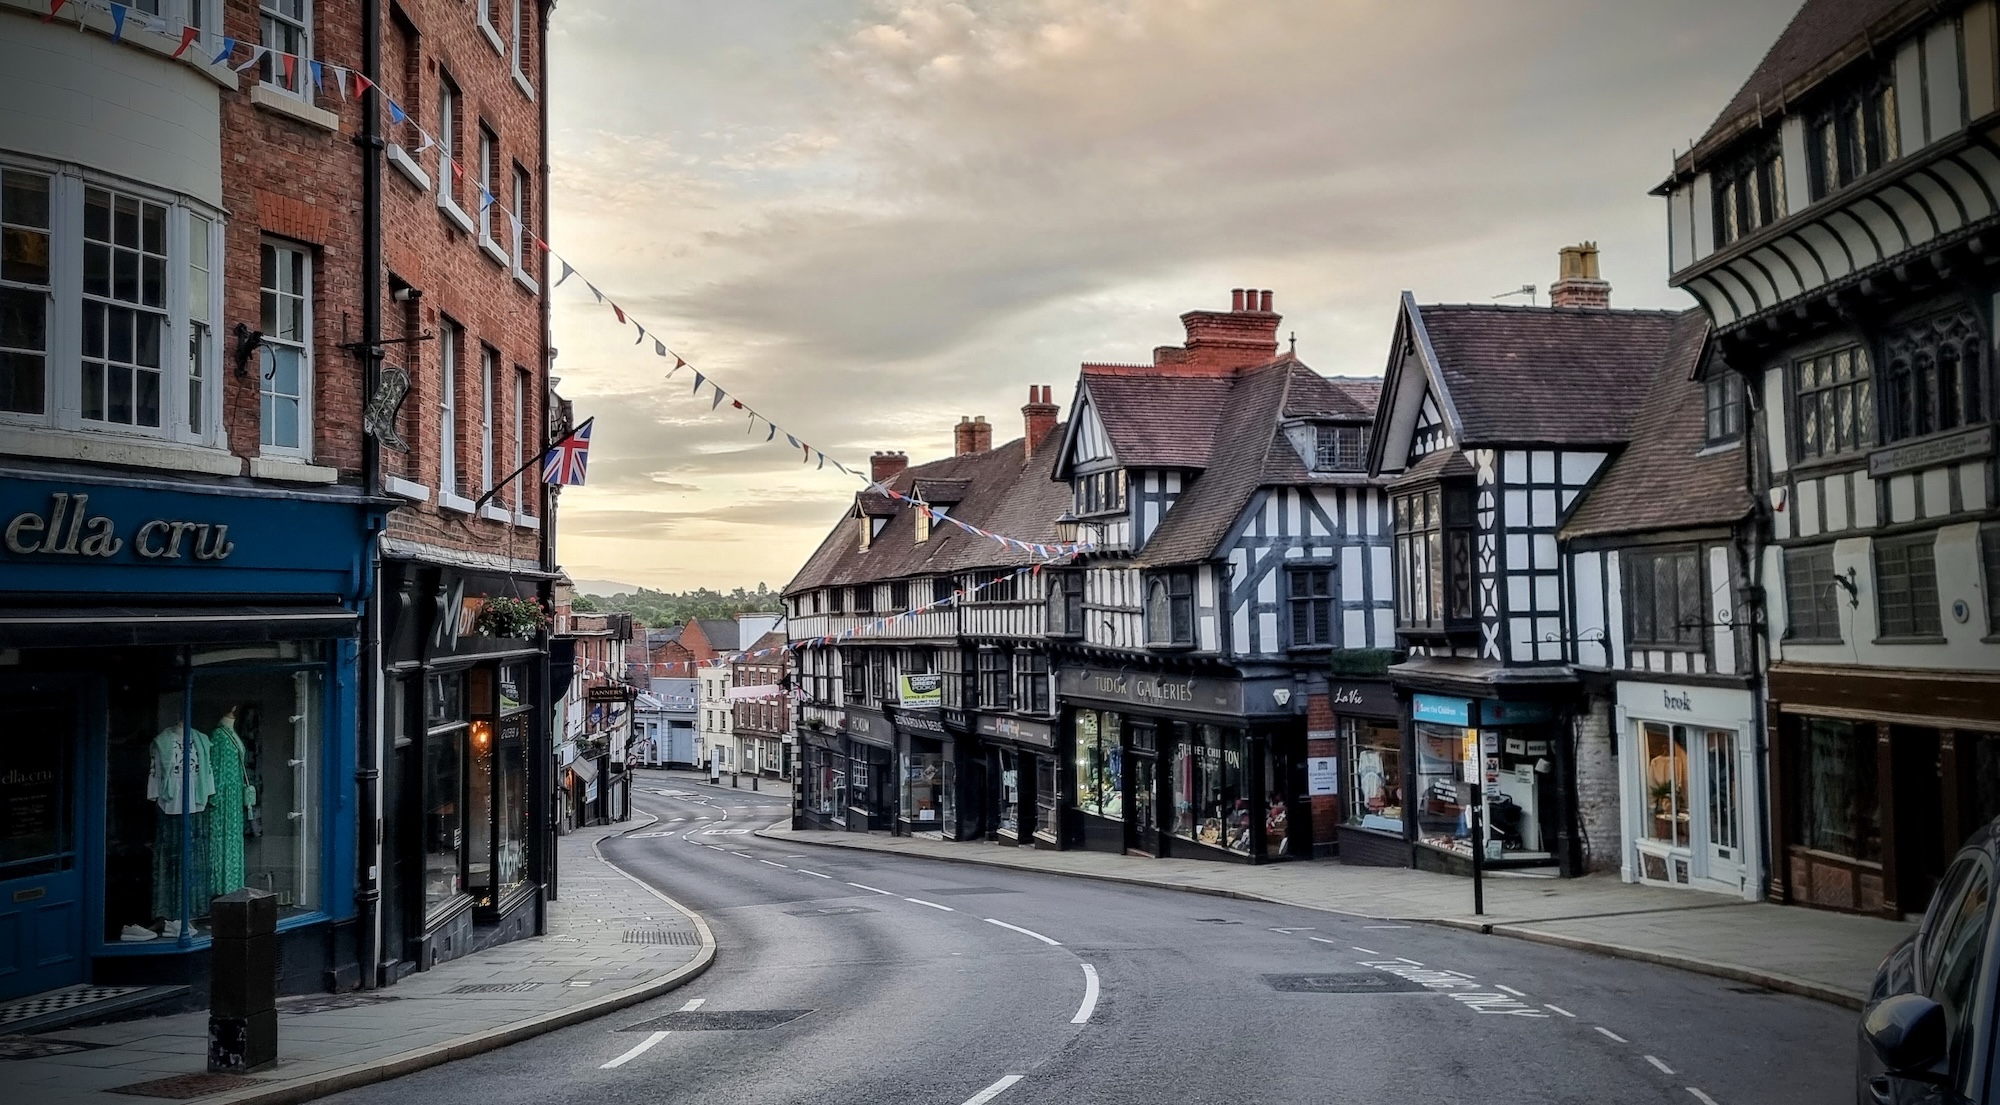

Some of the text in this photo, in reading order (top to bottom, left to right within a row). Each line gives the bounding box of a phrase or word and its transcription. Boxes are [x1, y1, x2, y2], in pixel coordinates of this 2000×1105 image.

[5, 492, 235, 560] ella cru
[1095, 676, 1192, 701] TUDOR GALLERIES
[1334, 686, 1363, 704] La Vie
[1420, 704, 1430, 712] Save
[1438, 706, 1456, 715] Children
[894, 715, 945, 732] EDWARDIAN BEDS
[1448, 992, 1550, 1018] ONLY
